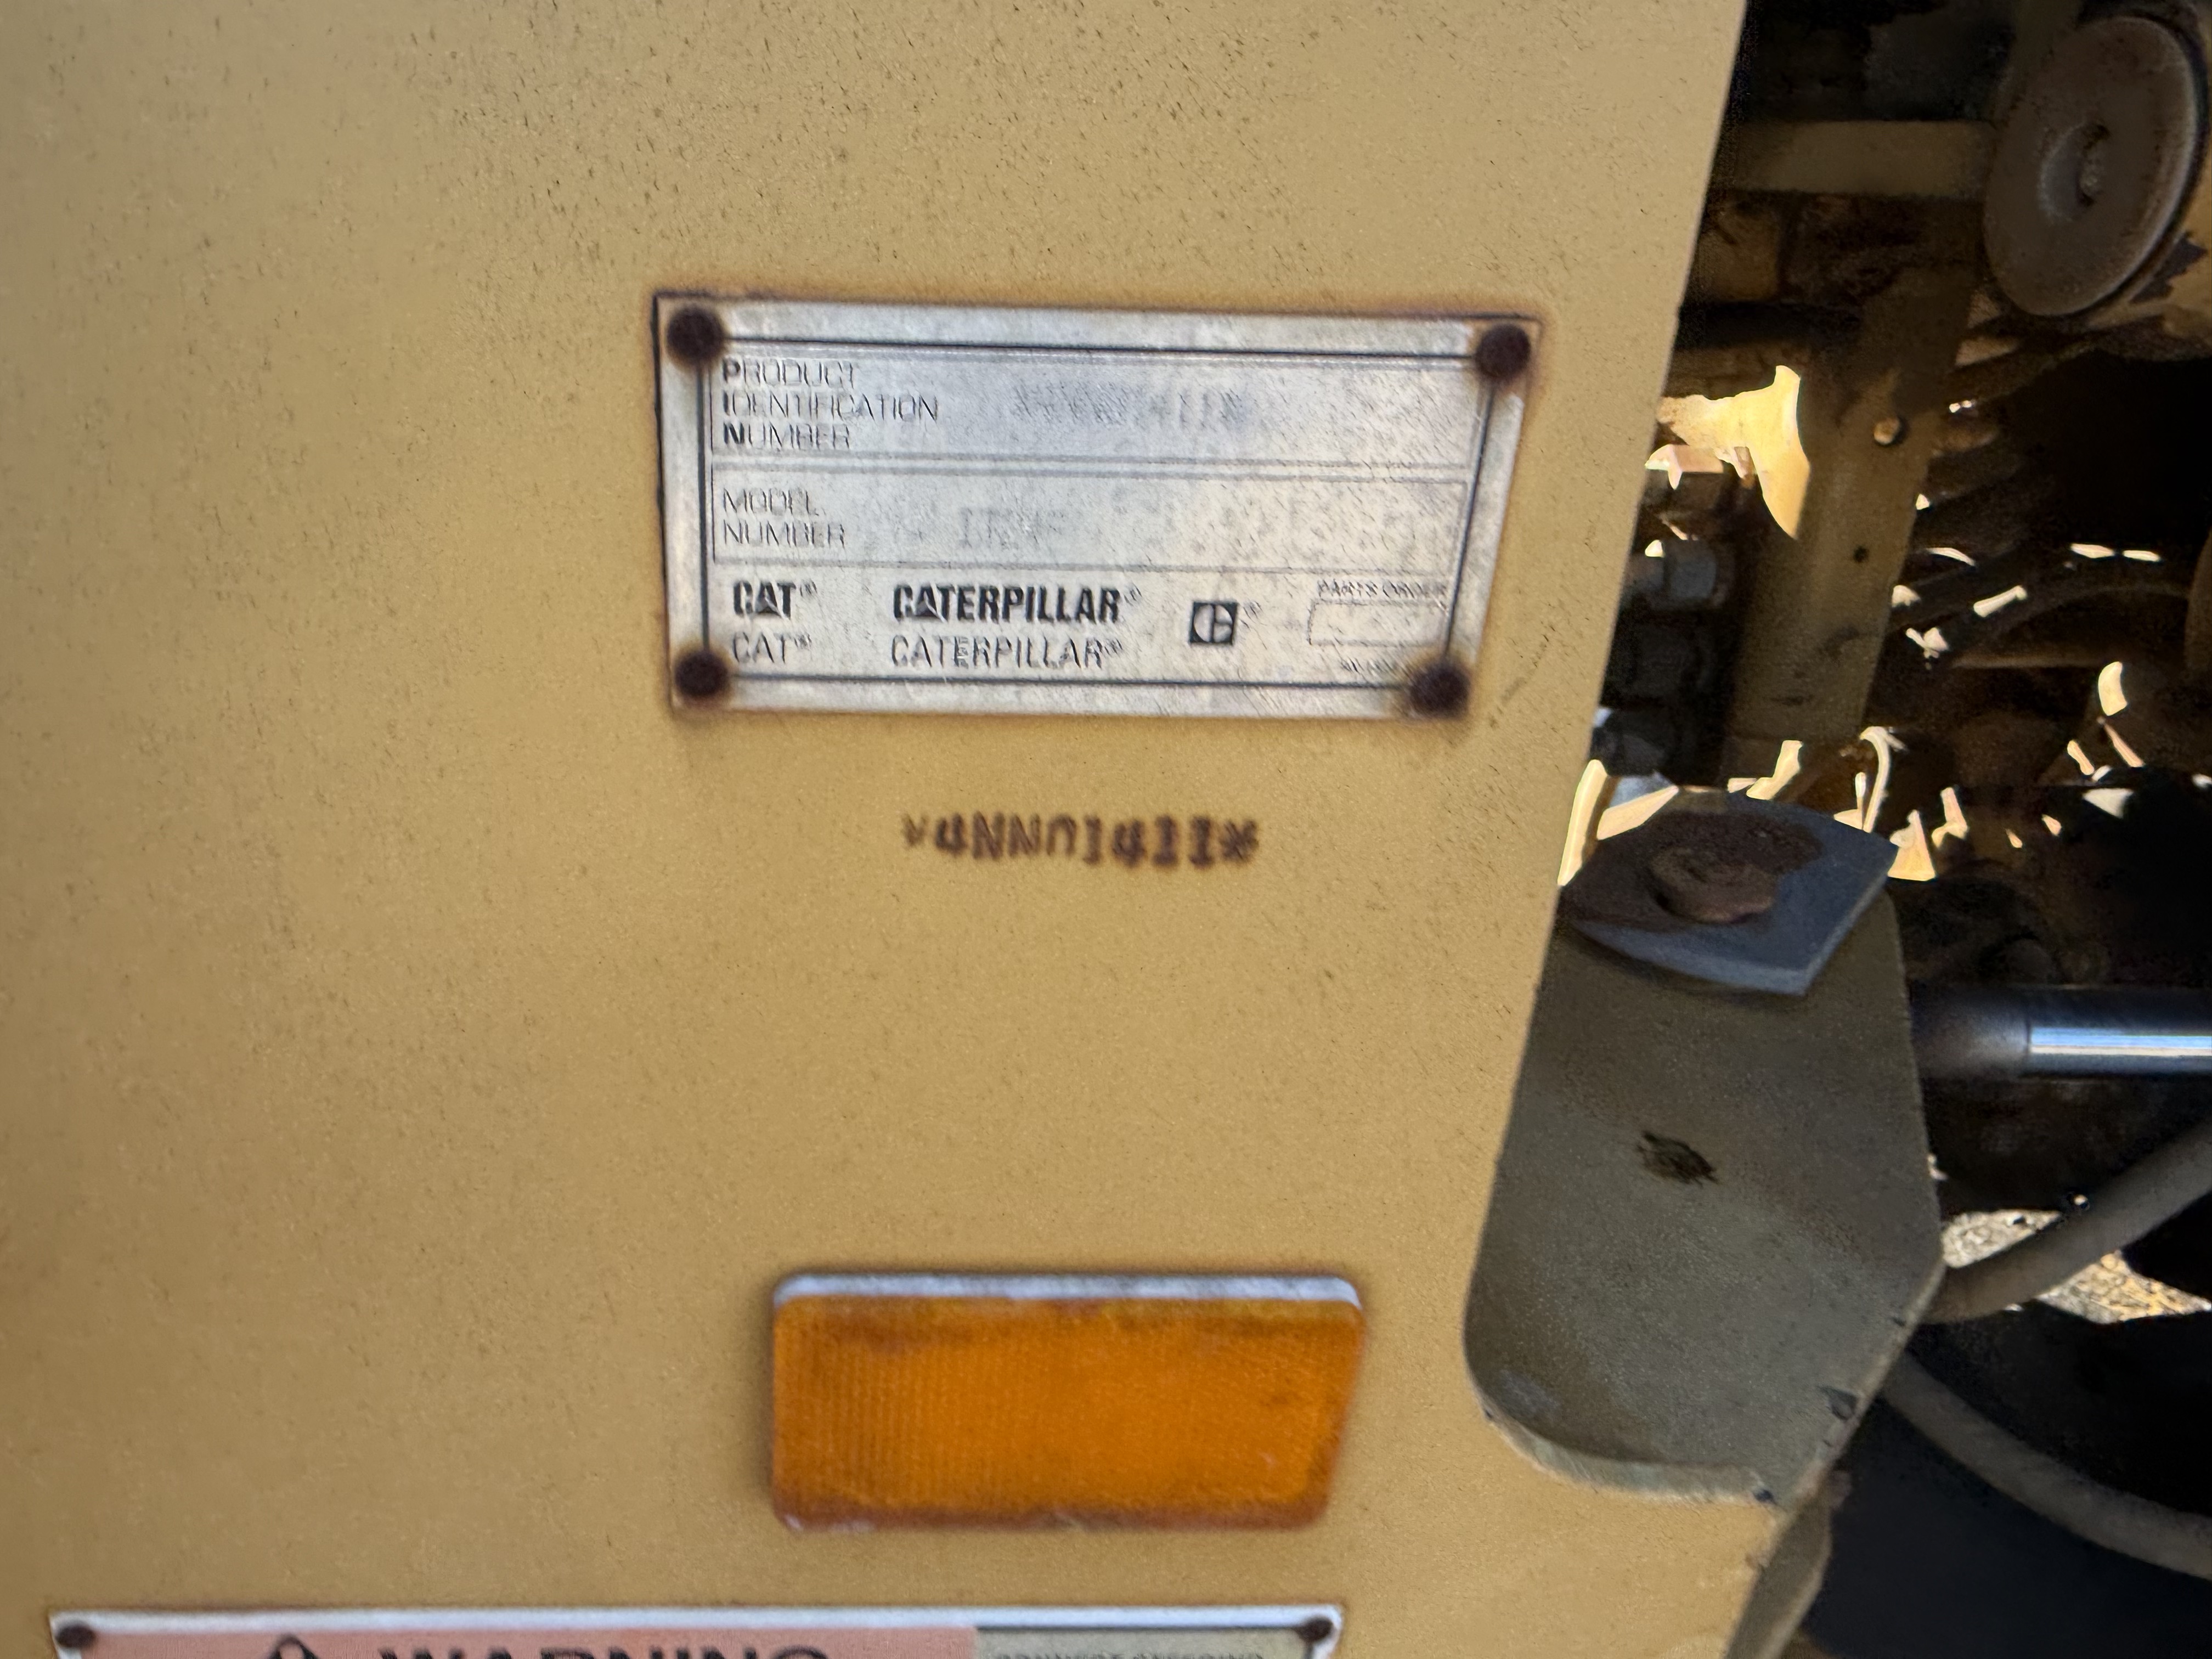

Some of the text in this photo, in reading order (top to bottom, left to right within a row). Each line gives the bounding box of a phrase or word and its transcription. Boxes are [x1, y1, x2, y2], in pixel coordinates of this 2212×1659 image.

[722, 358, 854, 389] PRODUCT
[722, 389, 939, 422] IDENTIFICATION
[722, 421, 851, 449] NUMBER
[723, 488, 818, 516] MODEL
[723, 520, 847, 548] NUMBER
